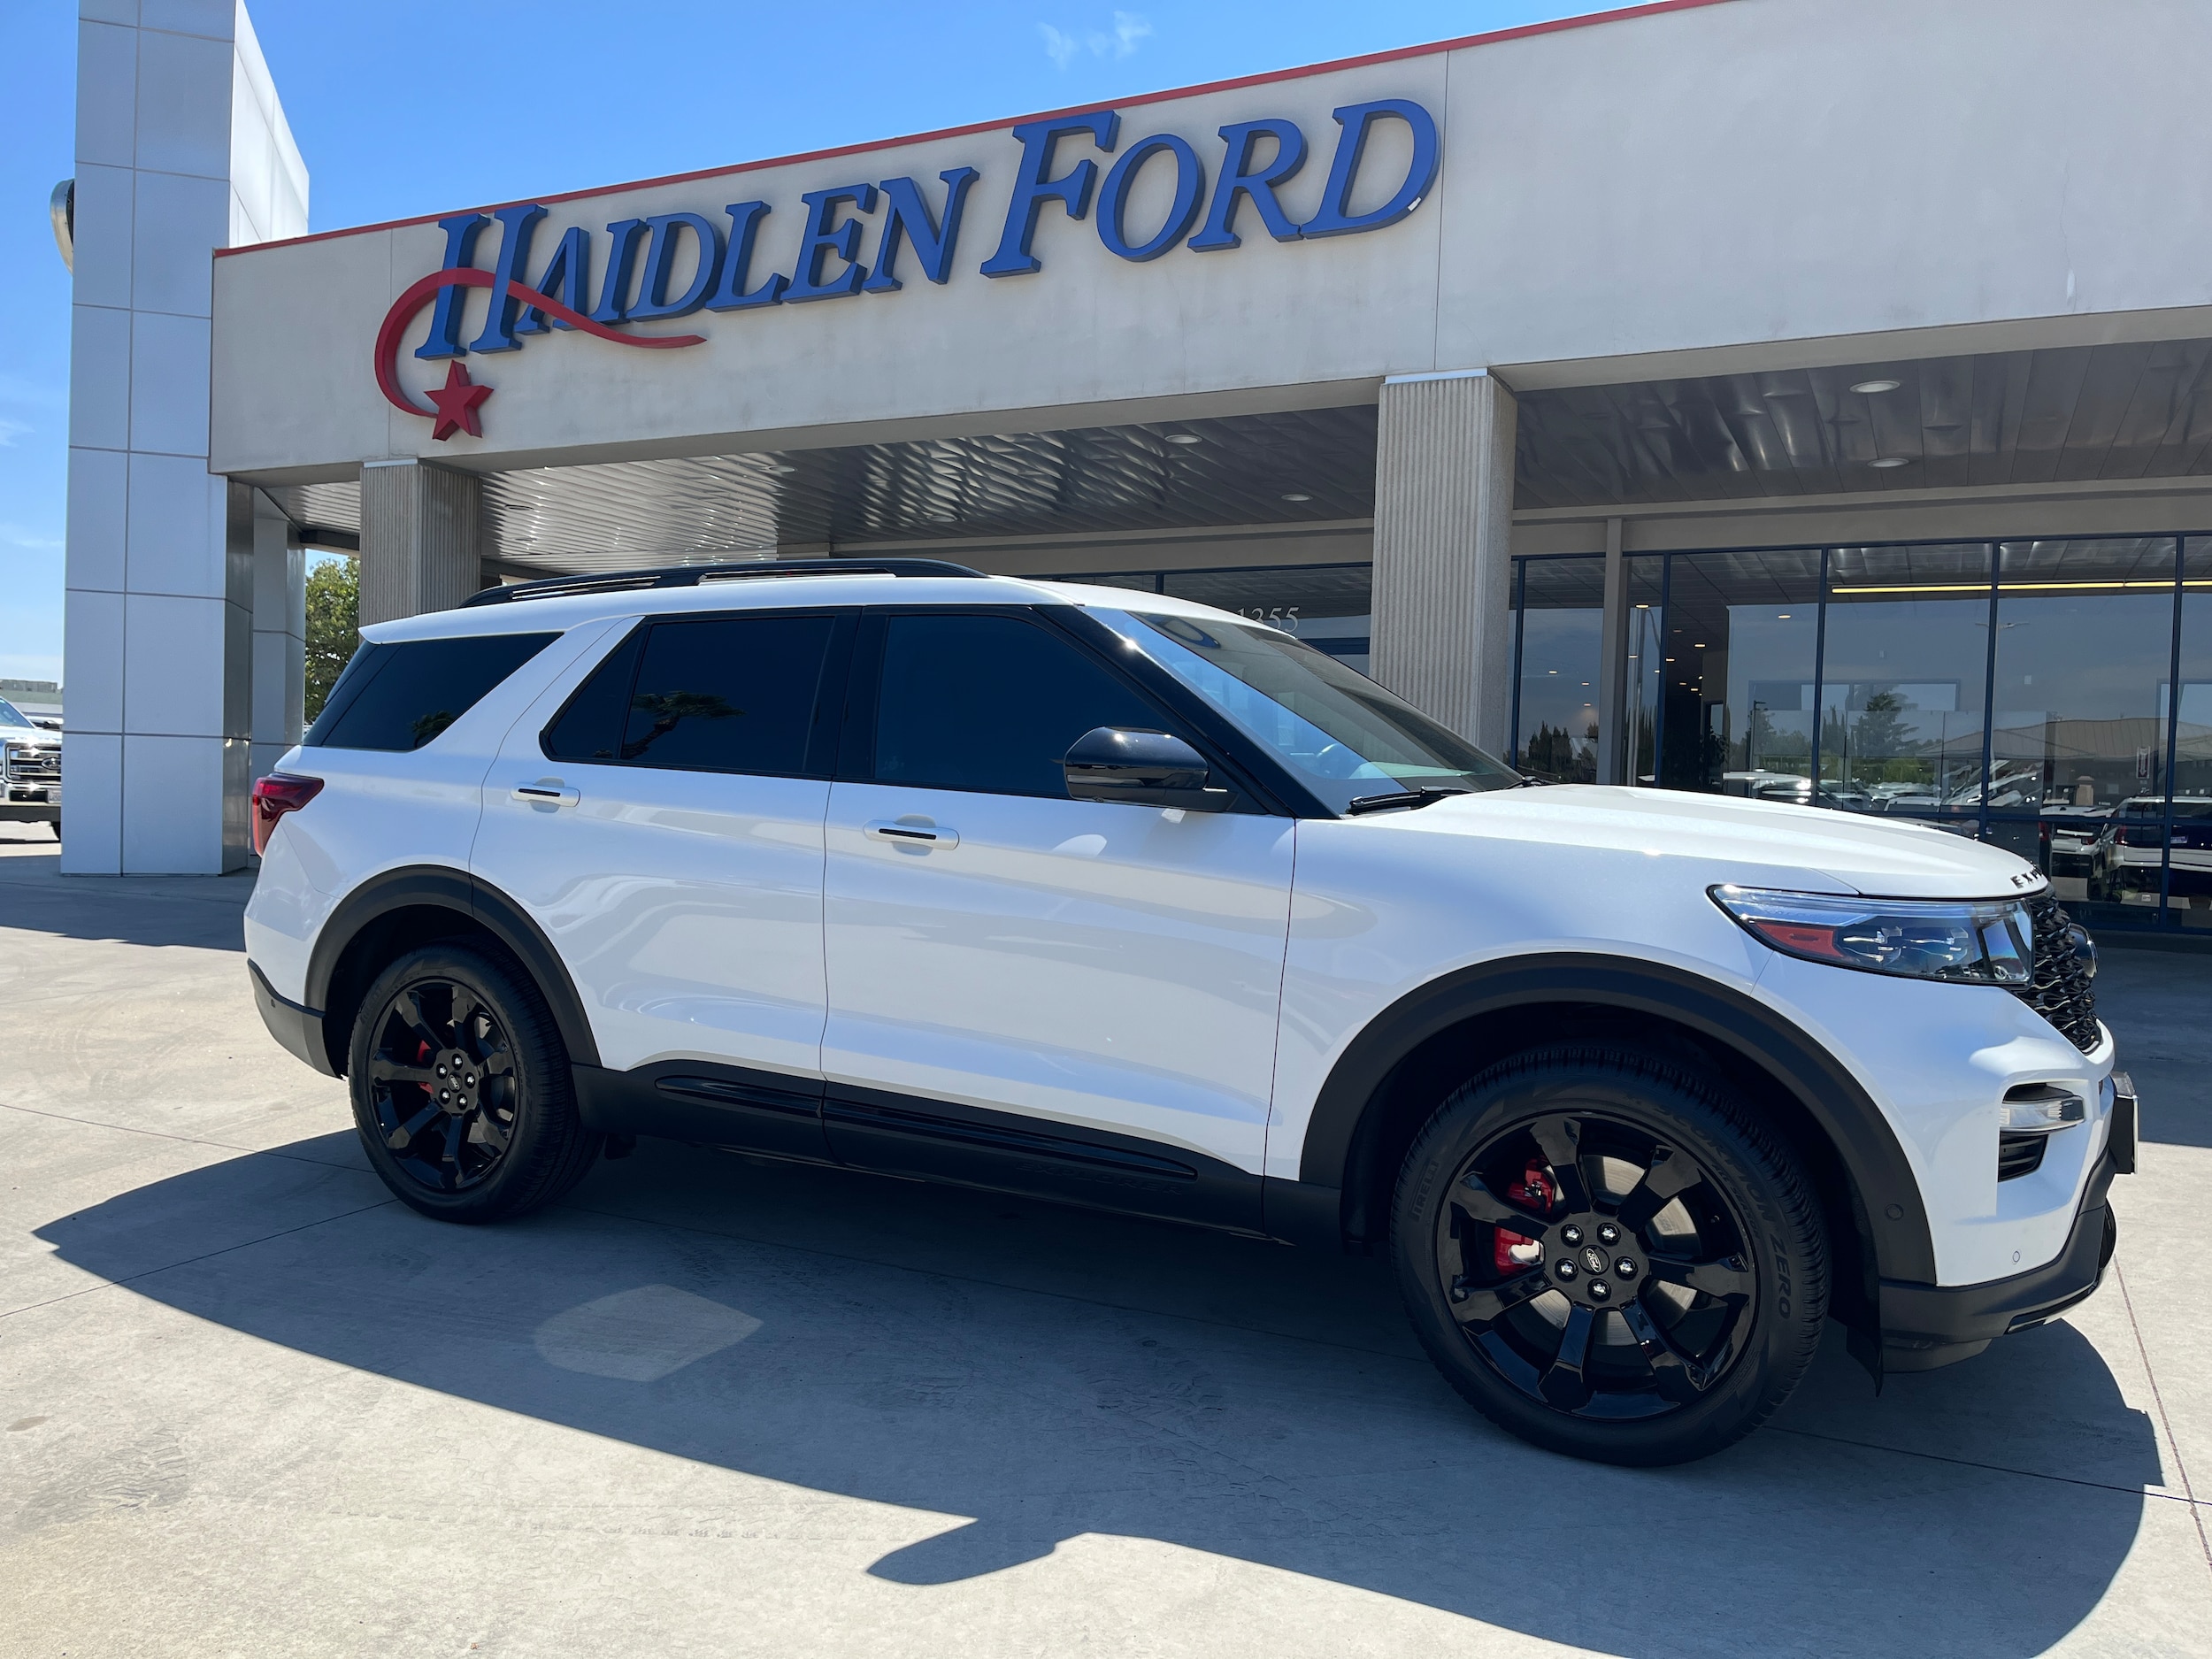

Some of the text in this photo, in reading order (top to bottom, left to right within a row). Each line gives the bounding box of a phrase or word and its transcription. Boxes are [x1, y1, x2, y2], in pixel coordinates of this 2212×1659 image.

[415, 98, 1441, 359] HAIDLEN FORD
[1408, 1157, 1439, 1223] PIRELLI
[1770, 1233, 1793, 1320] ZERO
